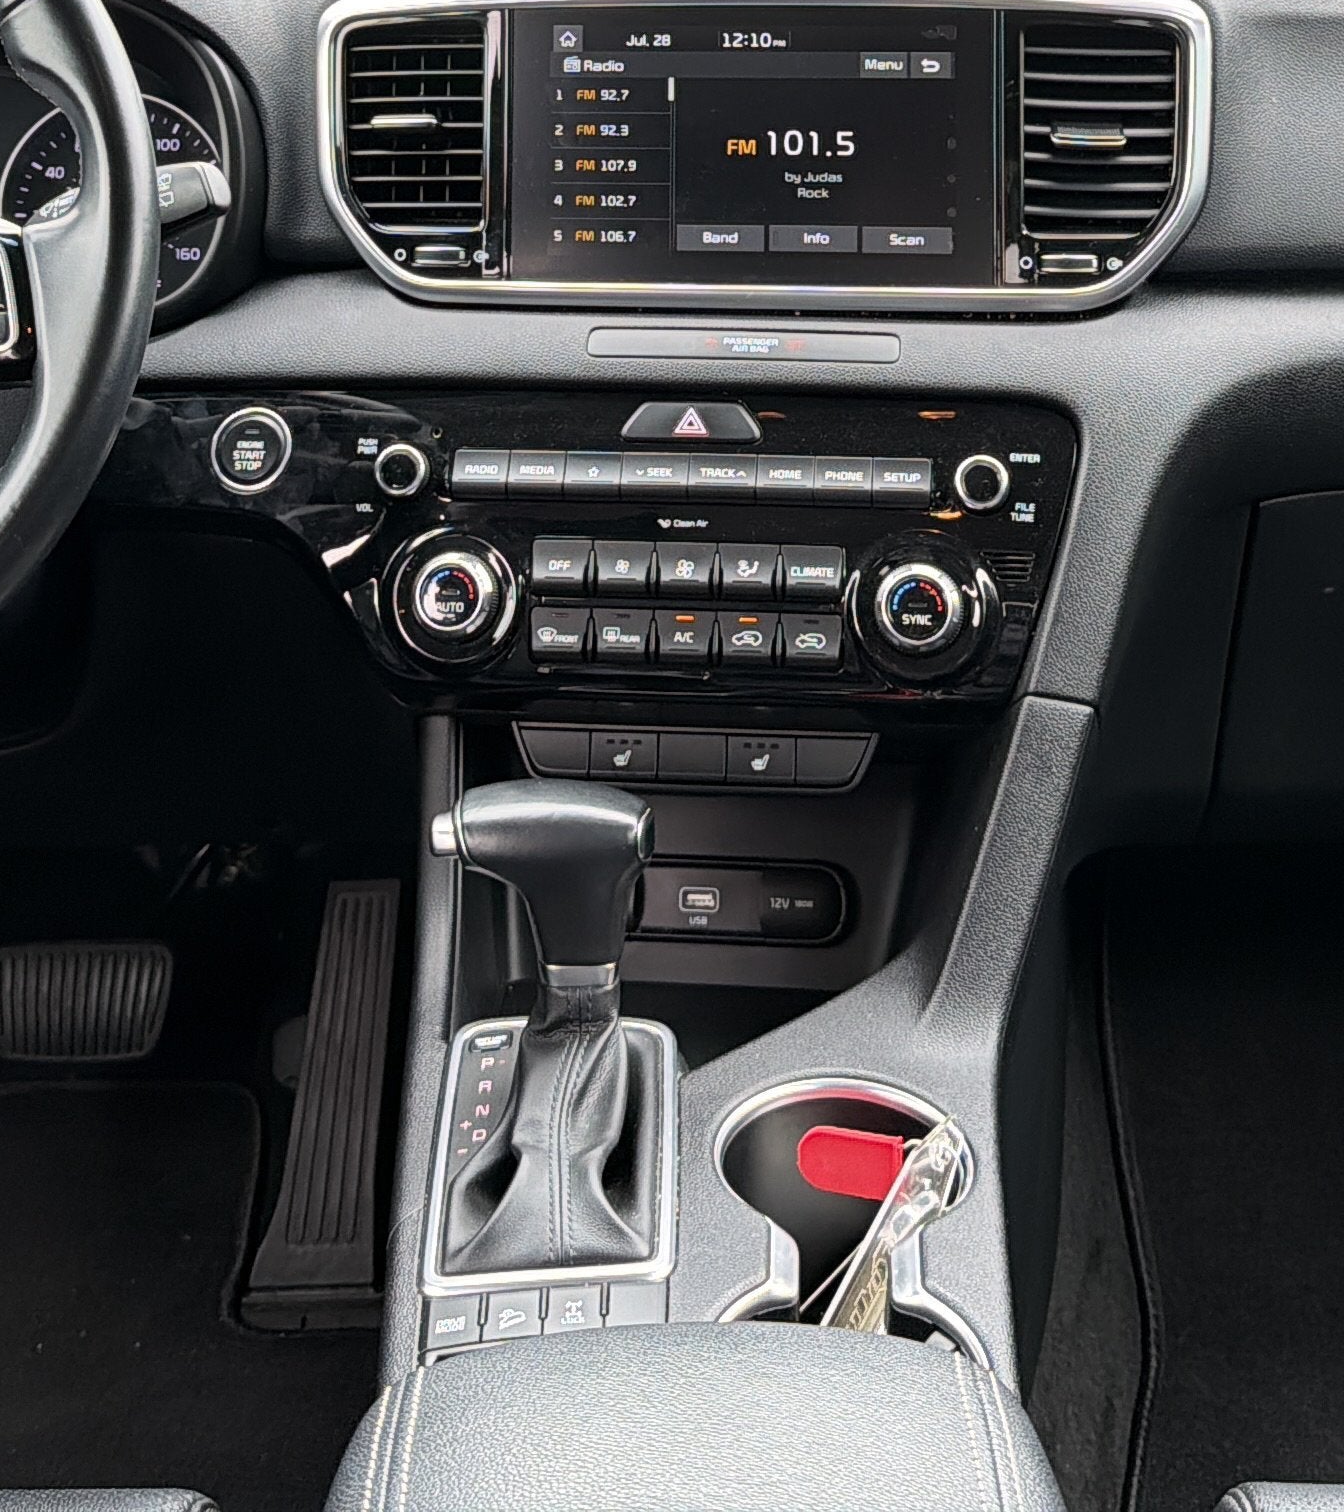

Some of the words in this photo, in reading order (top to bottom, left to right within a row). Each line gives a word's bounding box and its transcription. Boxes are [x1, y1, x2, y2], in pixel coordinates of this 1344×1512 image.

[652, 33, 671, 47] 28
[583, 59, 624, 73] Radio
[864, 58, 903, 71] Menu
[556, 90, 563, 101] 1
[576, 90, 595, 101] FM
[601, 90, 629, 102] 92.7
[554, 125, 563, 136] 2
[576, 125, 595, 136] FM
[601, 125, 629, 137] 92.3
[156, 139, 180, 152] 100
[726, 139, 756, 156] FM
[766, 130, 855, 158] 101.5
[554, 160, 563, 171] 3
[576, 160, 595, 171] FM
[601, 160, 636, 172] 107.9
[45, 166, 65, 179] 40
[785, 172, 801, 185] by
[803, 172, 843, 183] Judas
[797, 187, 829, 199] Rock
[554, 196, 563, 206] 4
[576, 196, 595, 206] FM
[601, 196, 636, 208] 102.7
[554, 231, 563, 242] 5
[576, 231, 595, 242] FM
[601, 231, 636, 243] 106.7
[703, 232, 738, 244] Band
[803, 233, 829, 245] Info
[889, 234, 924, 246] Scan
[175, 248, 200, 261] 160
[723, 337, 779, 346] PASSENGER
[233, 450, 266, 460] START
[1009, 452, 1040, 463] ENTER
[234, 460, 262, 471] STOP
[464, 464, 499, 474] RADIO
[519, 465, 555, 475] MEDIA
[646, 467, 673, 477] SEEK
[700, 467, 736, 478] TRACK
[769, 469, 802, 479] HOME
[825, 471, 864, 481] PHONE
[884, 472, 921, 482] SETUP
[356, 503, 373, 513] VOL
[1015, 502, 1036, 512] FILE
[1010, 512, 1034, 522] TUNE
[549, 560, 571, 571] OFF
[790, 567, 834, 578] CLIMATE
[436, 602, 464, 613] AUTO
[902, 614, 932, 625] SYNC
[555, 635, 578, 643] FRONT
[620, 635, 640, 643] REAR
[674, 632, 694, 644] A/C
[770, 897, 790, 909] 12V
[689, 916, 707, 925] USB
[475, 1104, 490, 1116] N
[472, 1129, 486, 1141] D
